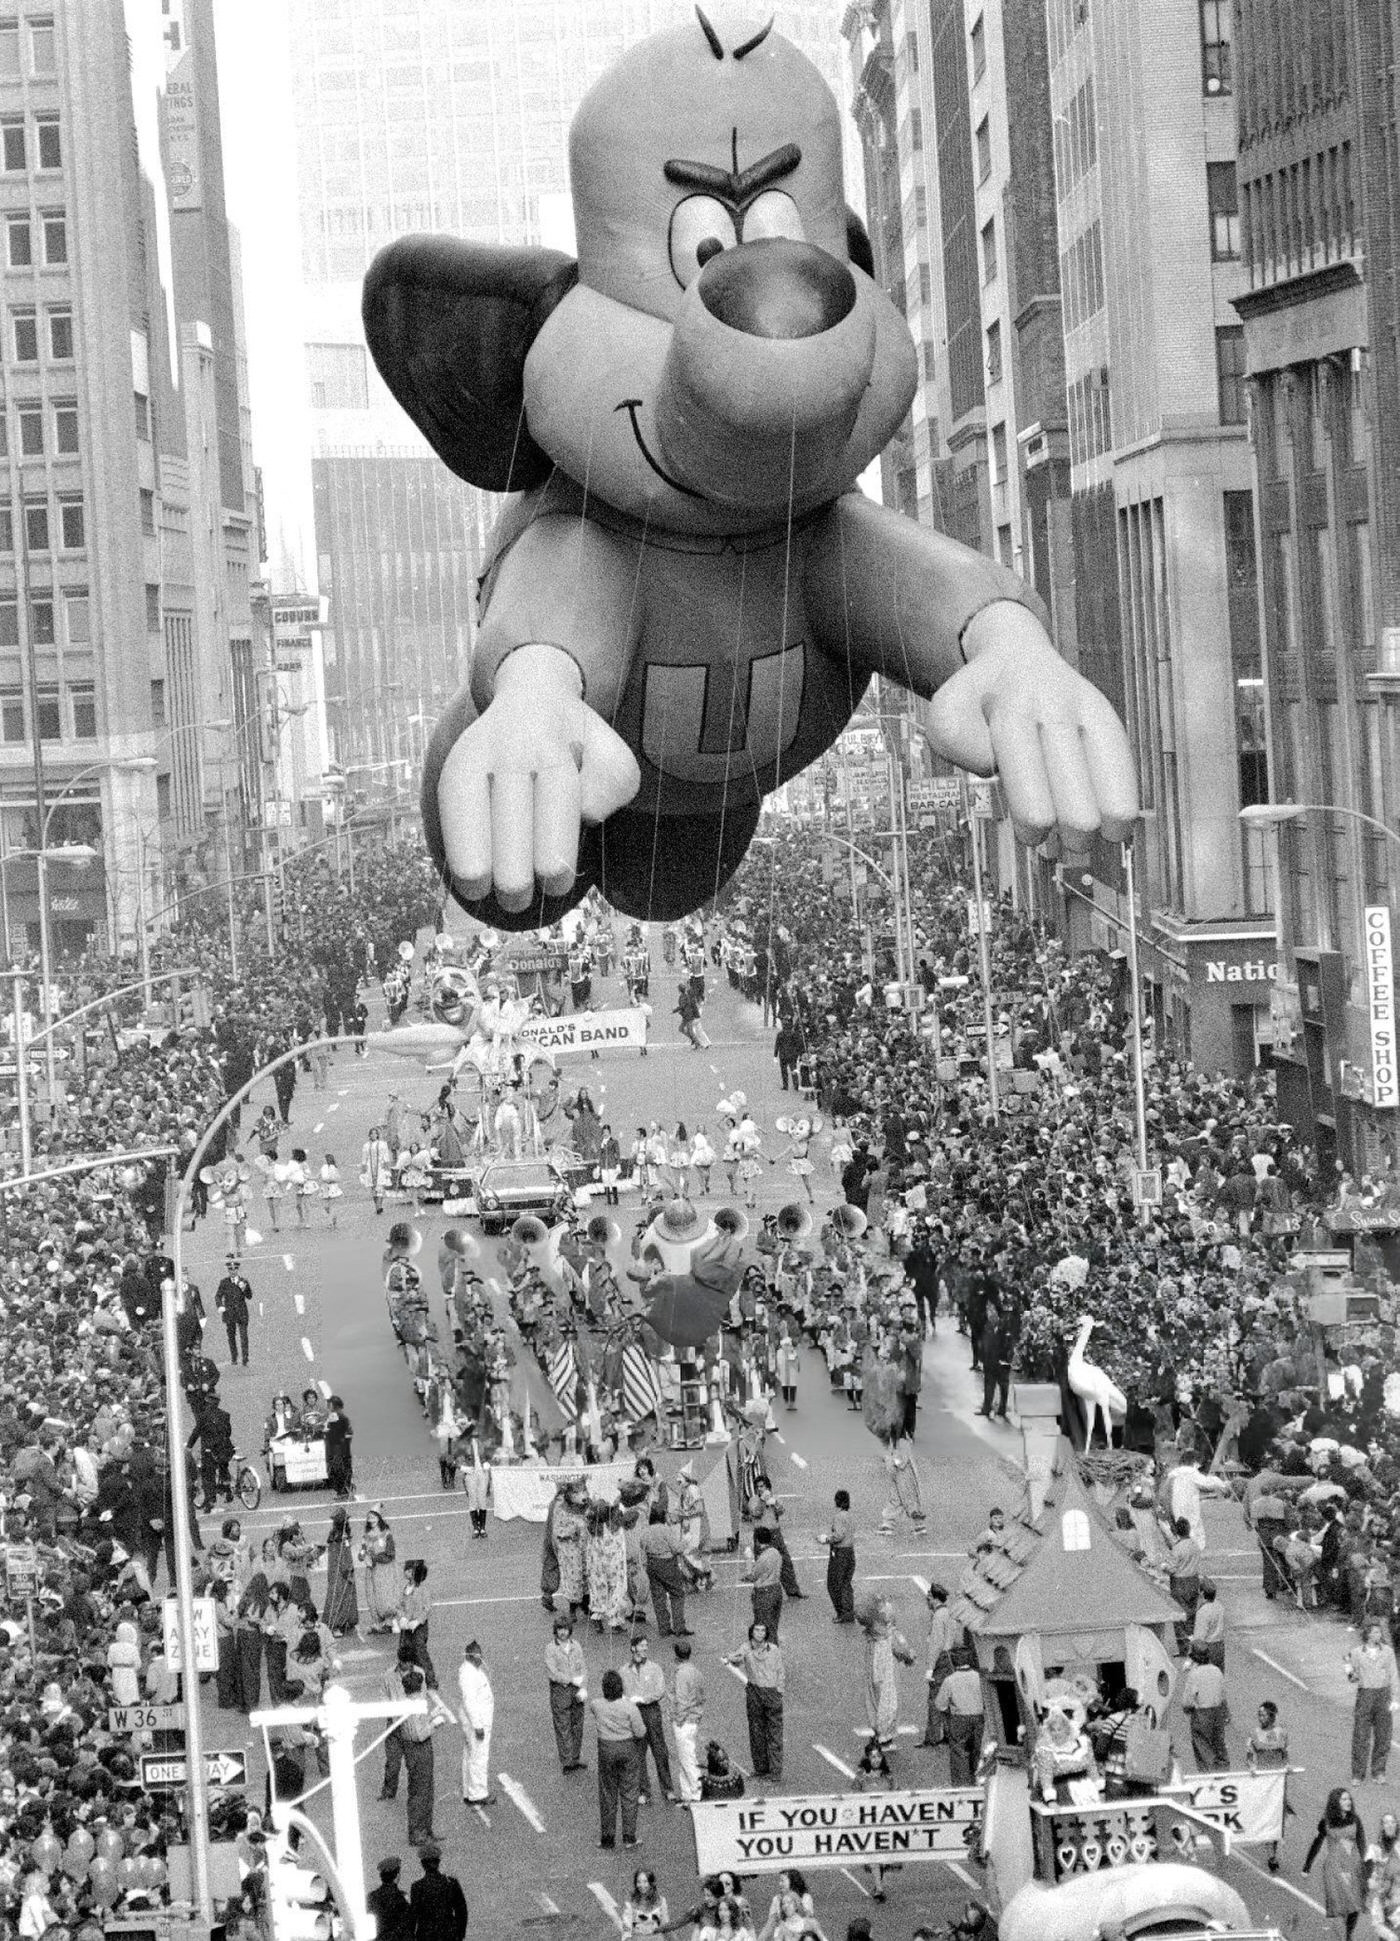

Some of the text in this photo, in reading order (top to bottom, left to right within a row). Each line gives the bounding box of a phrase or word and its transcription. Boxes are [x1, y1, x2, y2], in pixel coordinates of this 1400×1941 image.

[1367, 912, 1390, 1020] COFFEE
[521, 1023, 576, 1037] ONALD'S
[537, 1026, 629, 1047] CAN BAND
[1375, 1031, 1394, 1102] SHOP
[170, 1626, 210, 1640] AAY
[170, 1645, 211, 1658] ZE
[114, 1710, 128, 1728] W
[134, 1709, 157, 1728] 36
[150, 1762, 230, 1780] ONE AY
[738, 1800, 984, 1830] IF YOU HAVEN'T
[737, 1836, 793, 1857] YOU
[815, 1828, 940, 1853] HAVEN'T
